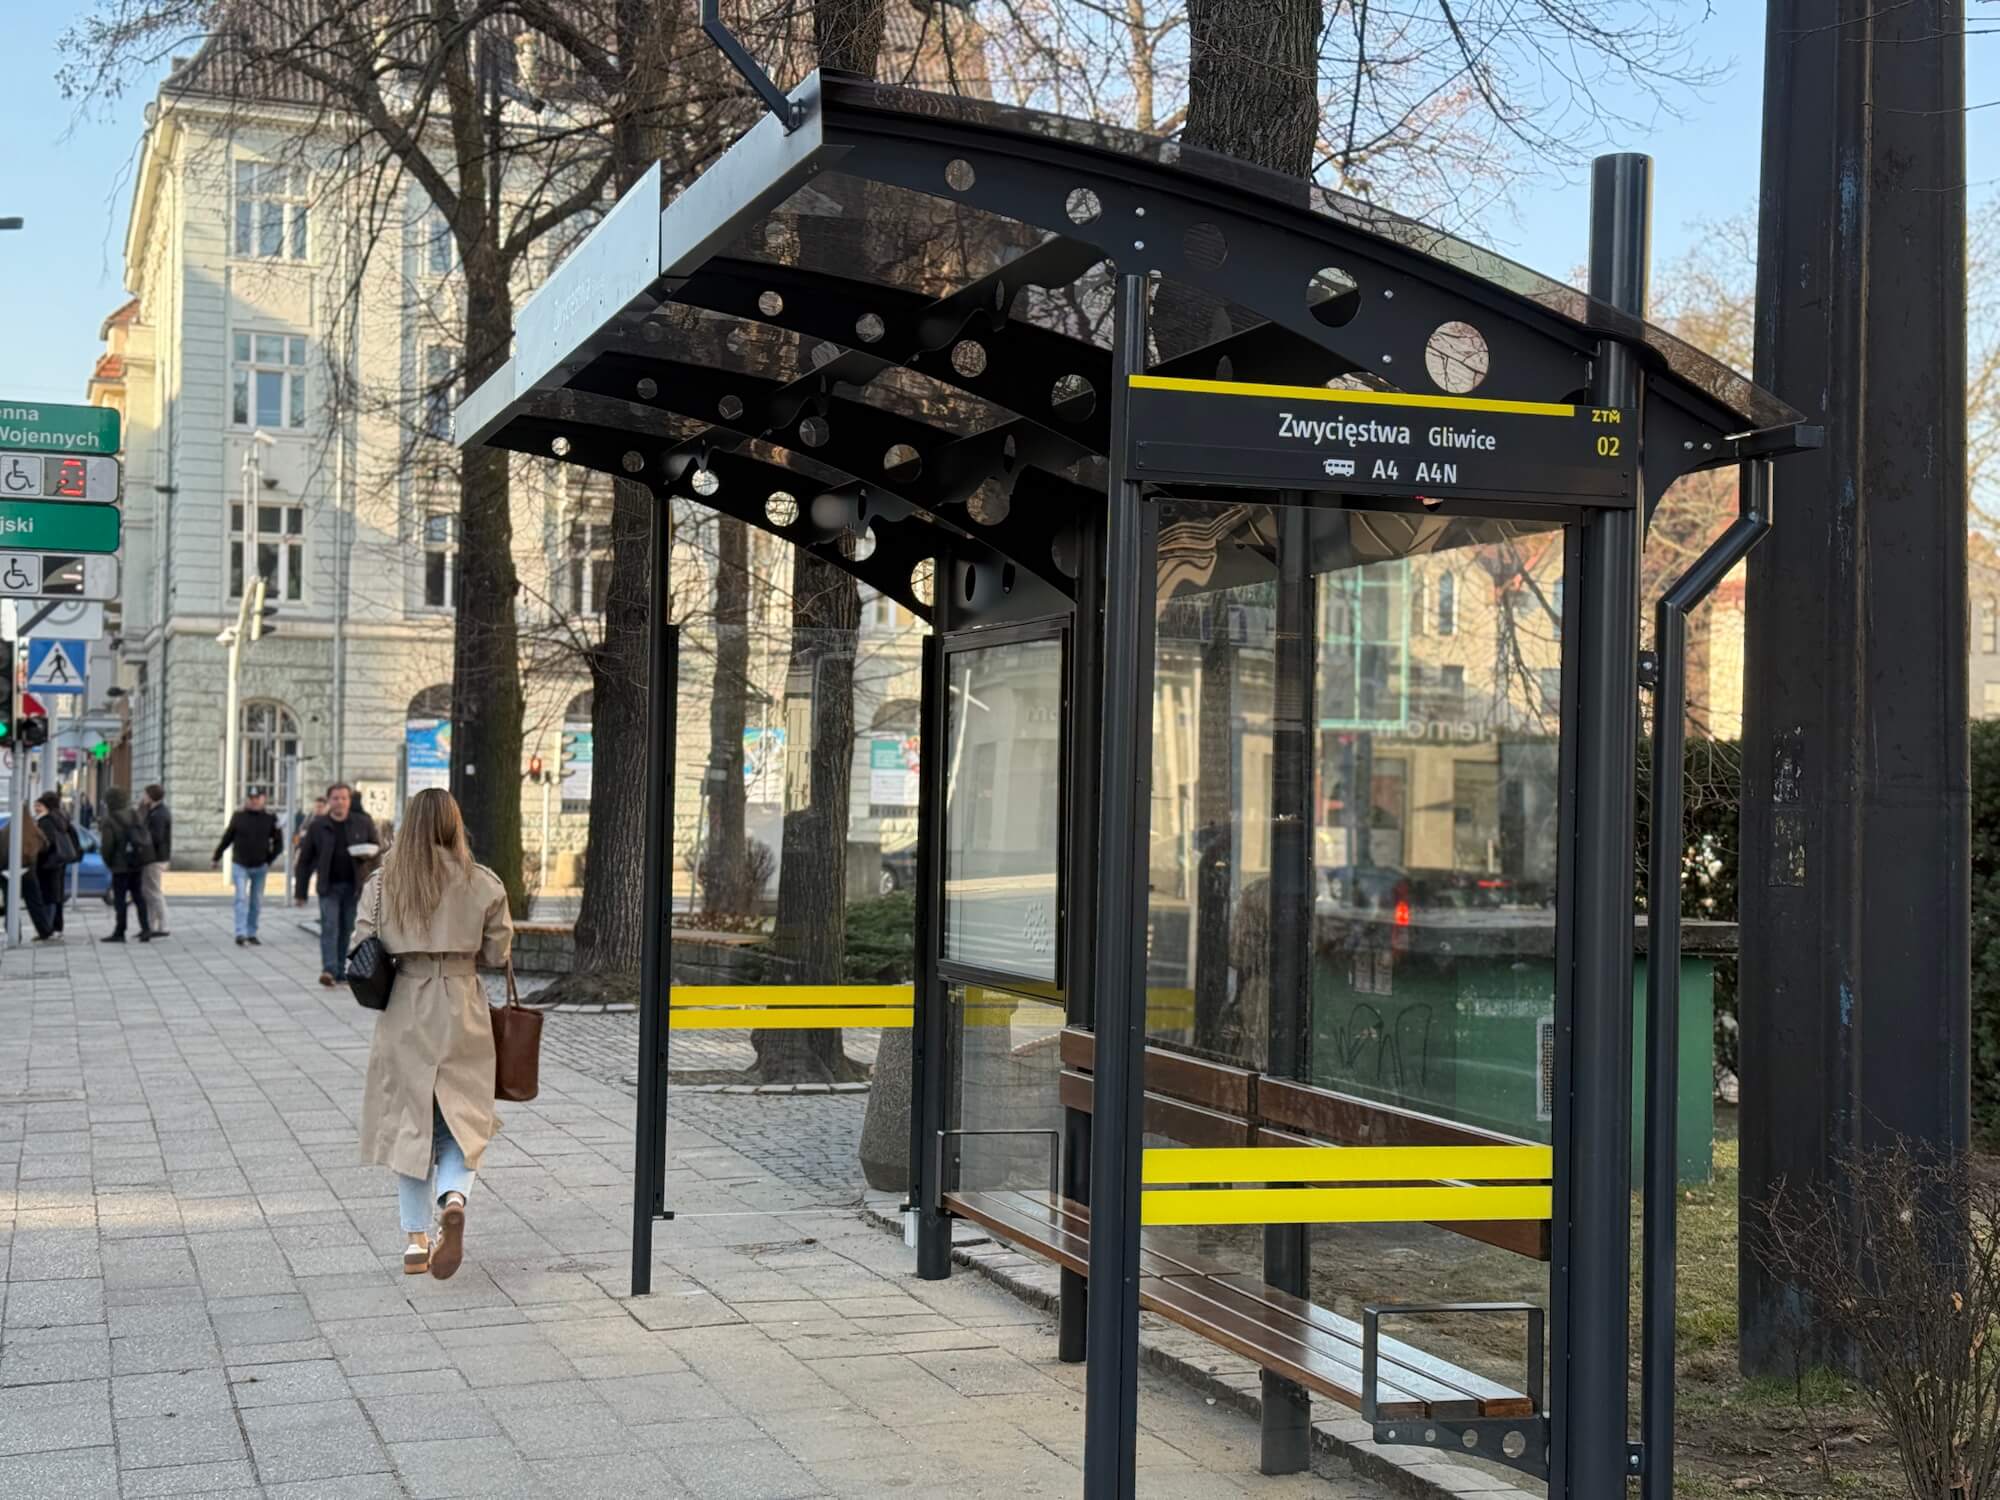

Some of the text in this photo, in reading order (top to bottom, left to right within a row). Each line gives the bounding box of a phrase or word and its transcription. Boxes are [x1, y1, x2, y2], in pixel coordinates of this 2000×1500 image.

[0, 407, 39, 421] nna
[1591, 409, 1621, 424] ZTM
[1278, 412, 1497, 450] Zwycięstwa Gliwice
[1597, 436, 1620, 456] 02
[1372, 459, 1458, 484] A4 A4N
